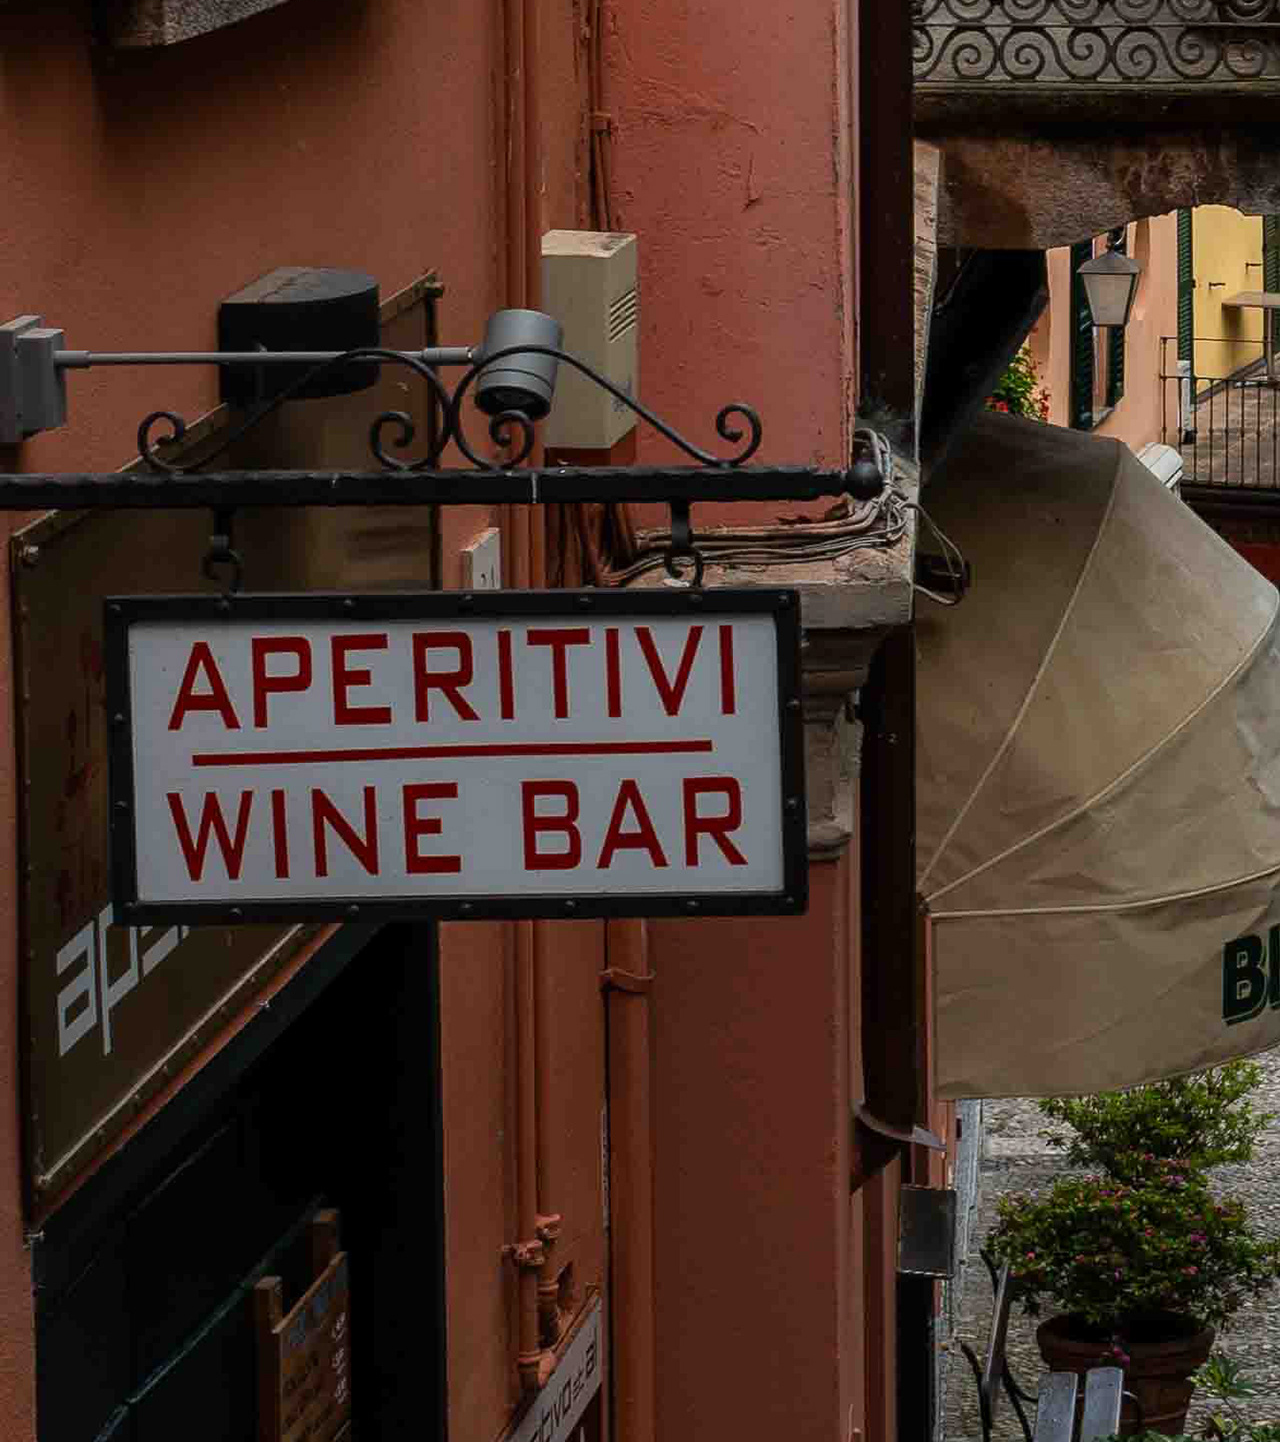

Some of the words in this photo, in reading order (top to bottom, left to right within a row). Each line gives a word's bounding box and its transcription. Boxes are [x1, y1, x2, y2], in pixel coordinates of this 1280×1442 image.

[167, 624, 736, 731] APERITIVI
[166, 781, 461, 882] WINE
[521, 775, 748, 871] BAR
